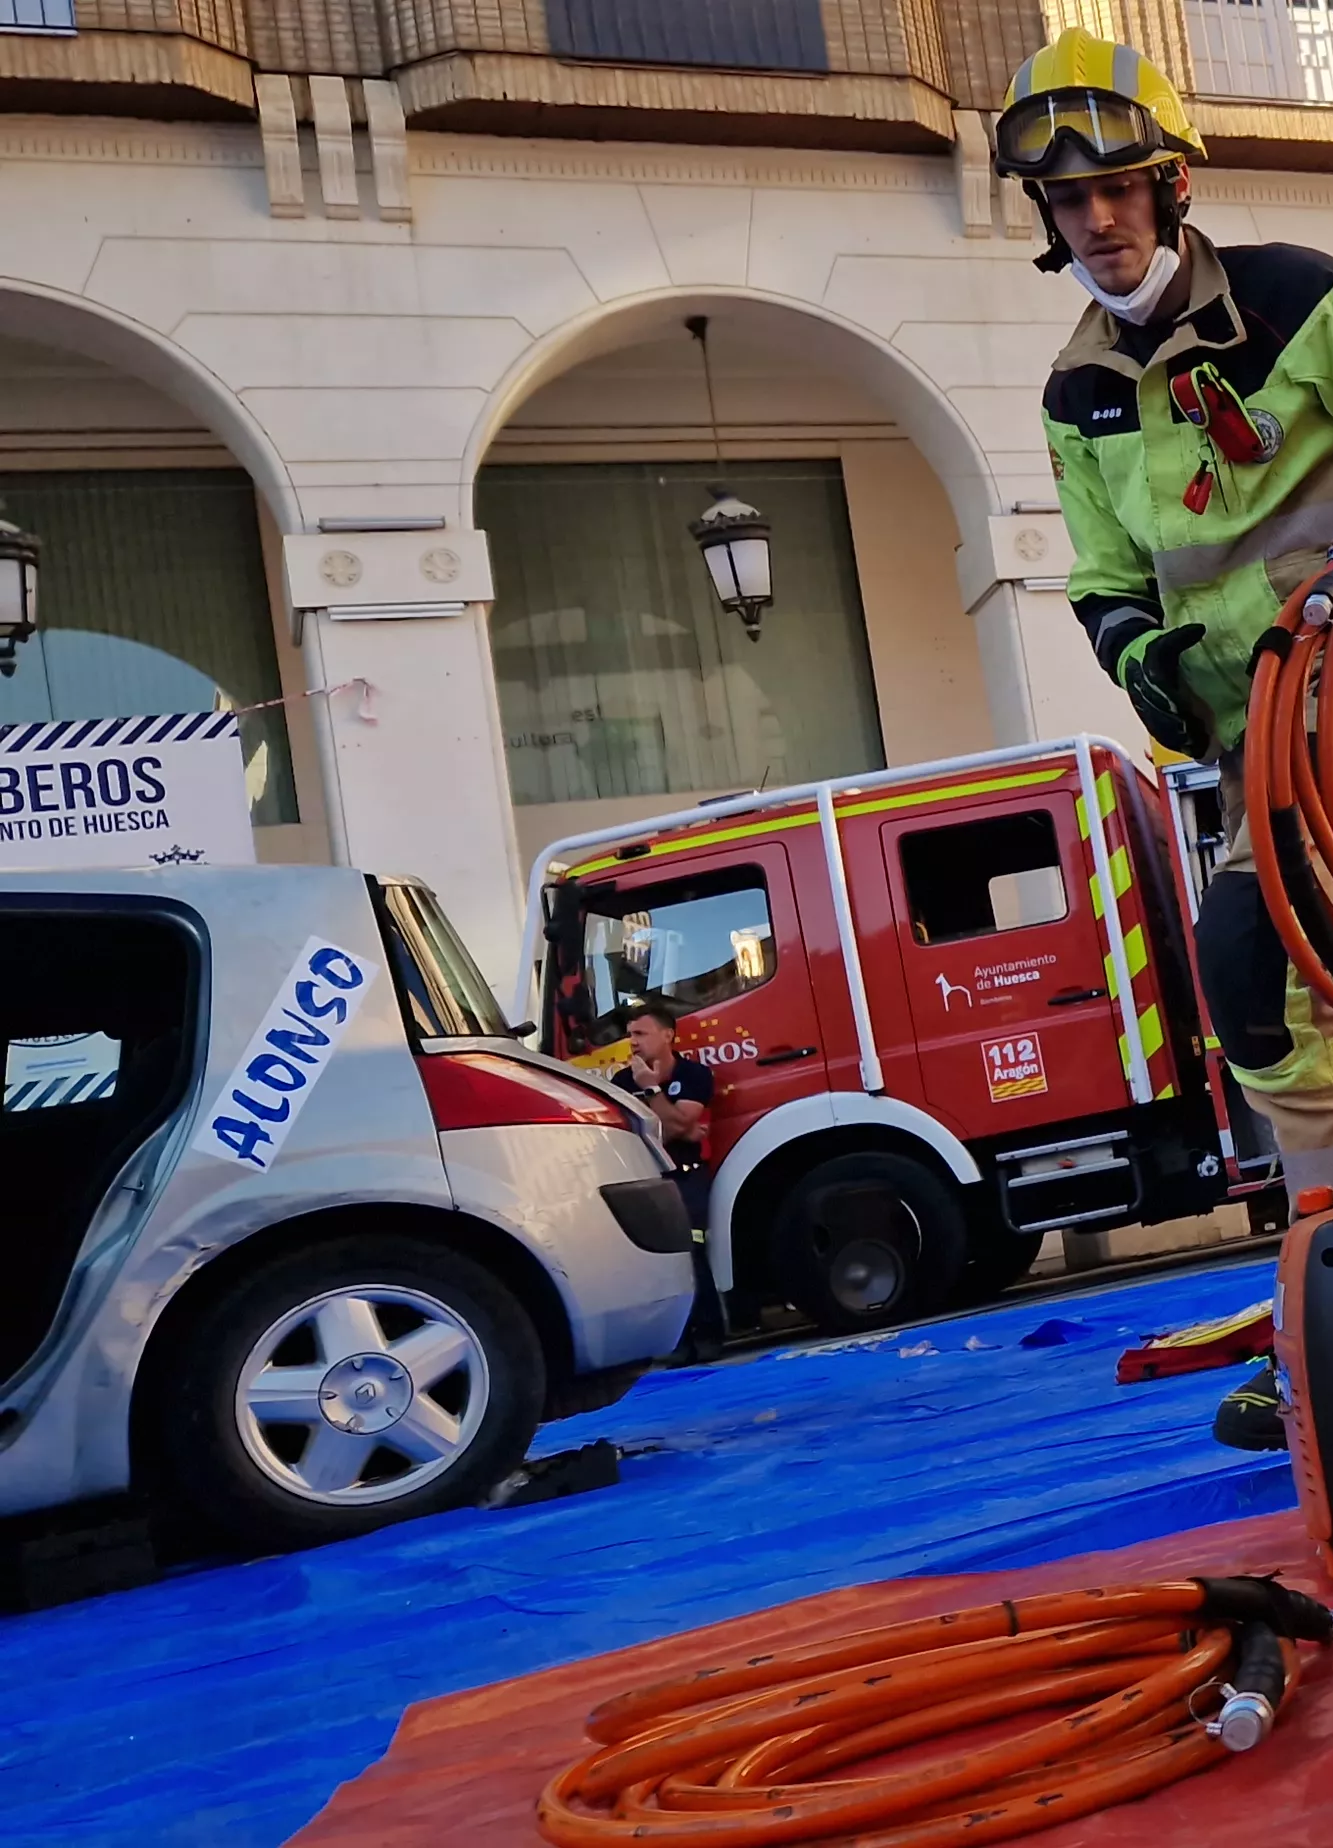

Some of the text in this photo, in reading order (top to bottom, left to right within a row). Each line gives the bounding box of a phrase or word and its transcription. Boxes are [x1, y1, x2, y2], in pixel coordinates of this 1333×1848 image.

[50, 816, 78, 837] DE
[83, 809, 170, 834] HUESCA
[974, 954, 1057, 979] Ayuntamiento
[976, 970, 1040, 991] de Huesca
[212, 948, 363, 1168] ALONSO
[988, 1039, 1036, 1066] 112
[994, 1062, 1039, 1081] Aragón
